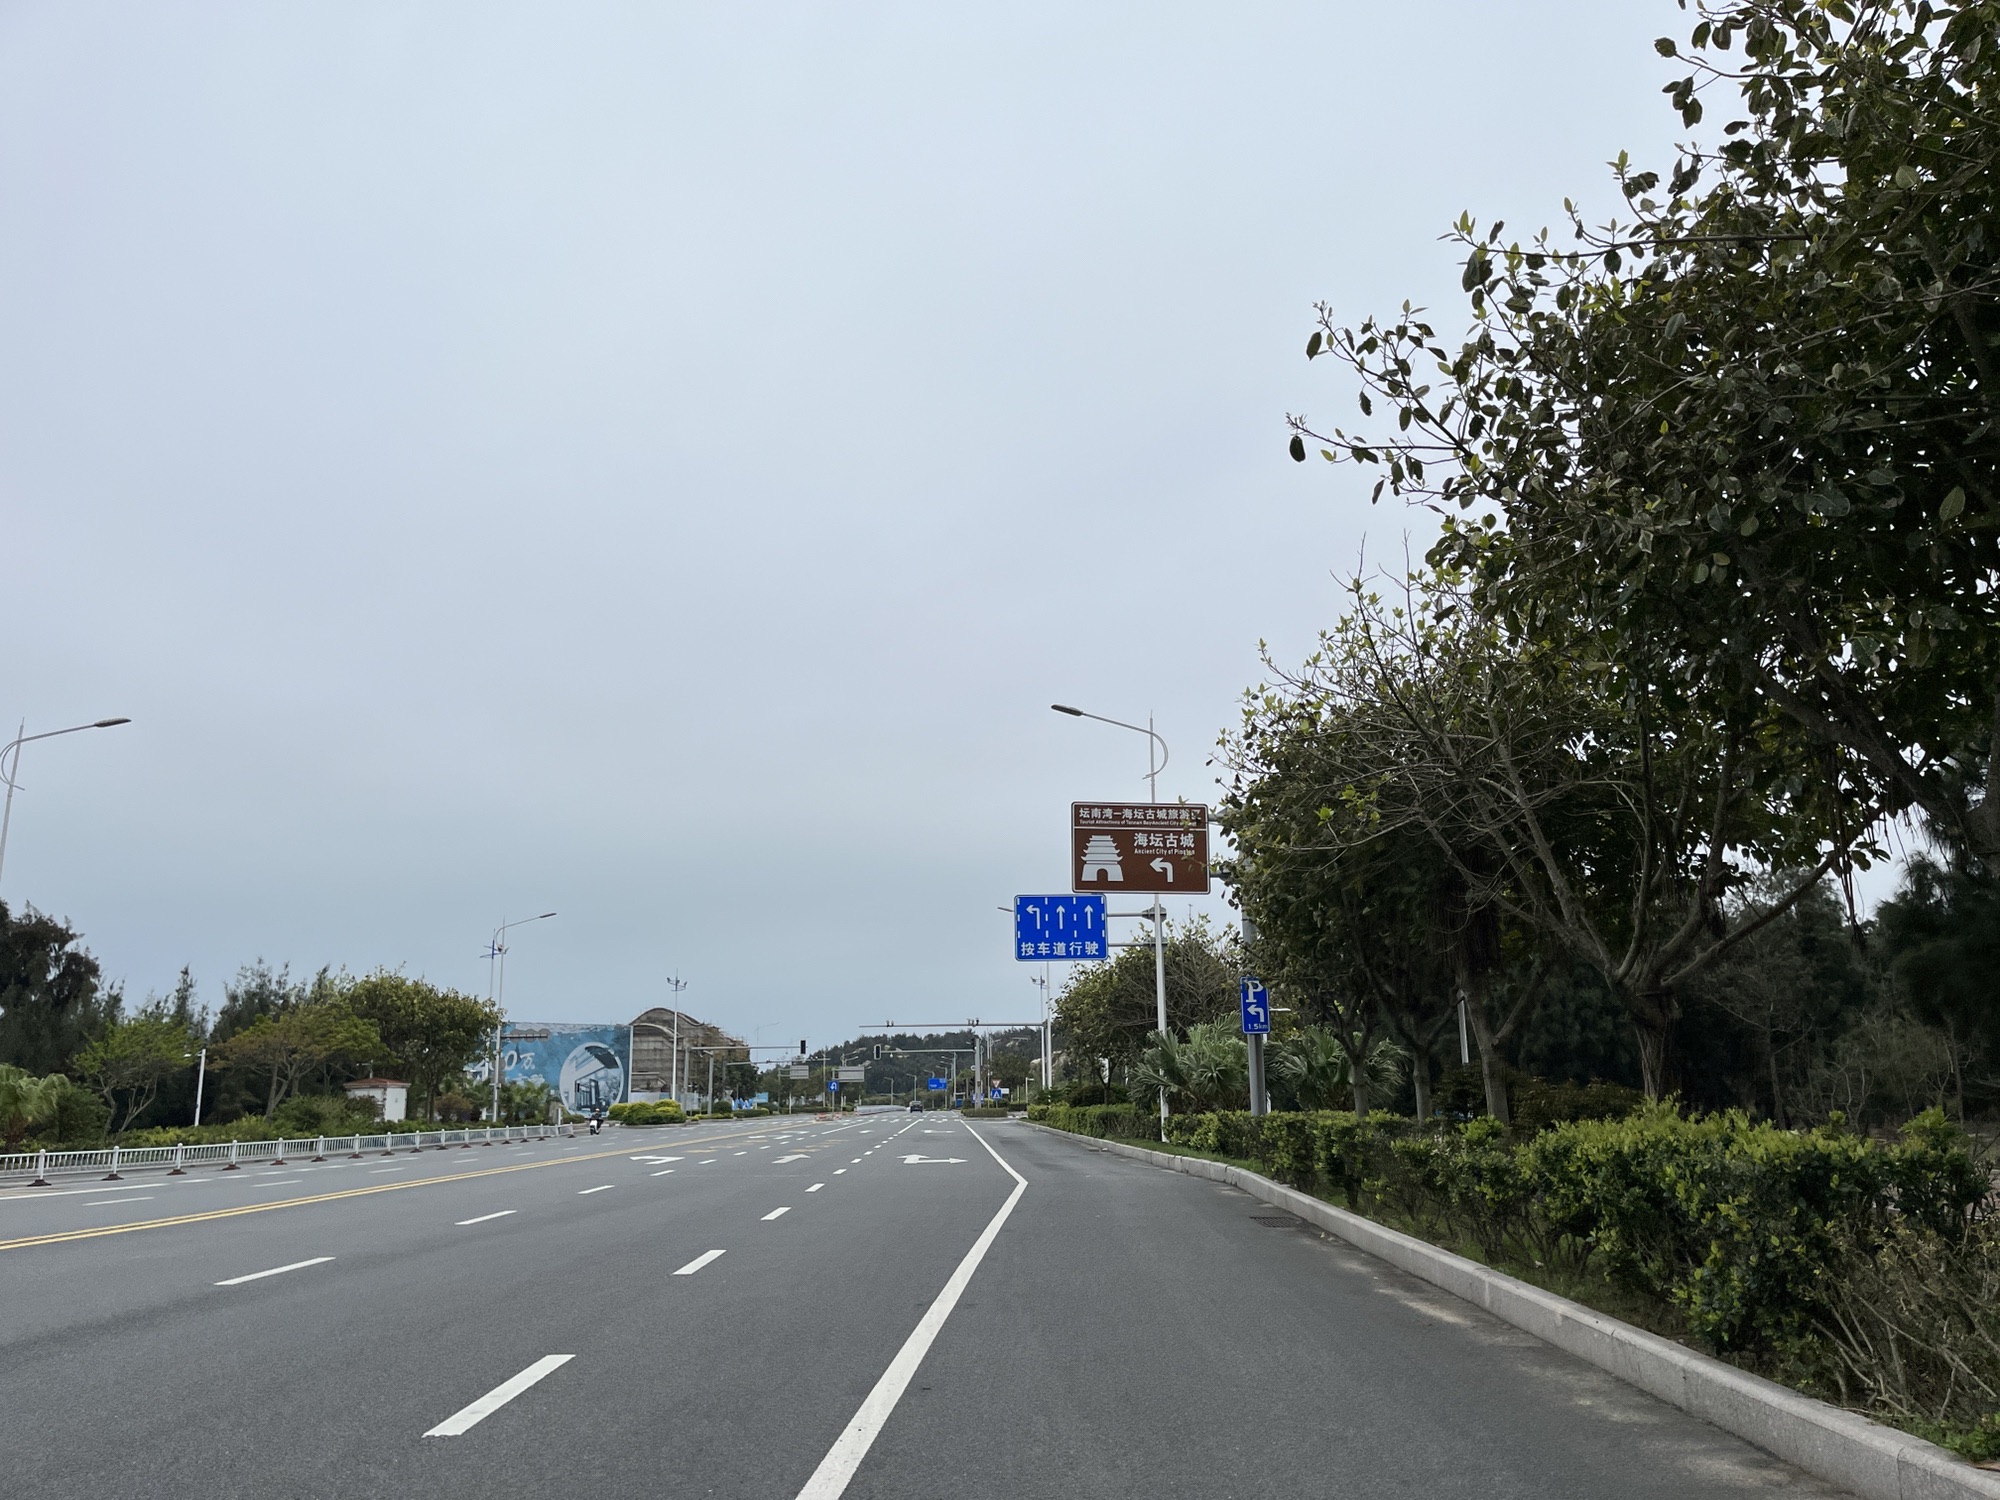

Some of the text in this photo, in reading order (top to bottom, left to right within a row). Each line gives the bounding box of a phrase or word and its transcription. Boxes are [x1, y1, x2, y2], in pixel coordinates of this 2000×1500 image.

[1133, 832, 1195, 848] 海坛古城
[1156, 848, 1167, 856] City
[1020, 941, 1099, 956] 按车道行驶
[1245, 981, 1264, 1003] P
